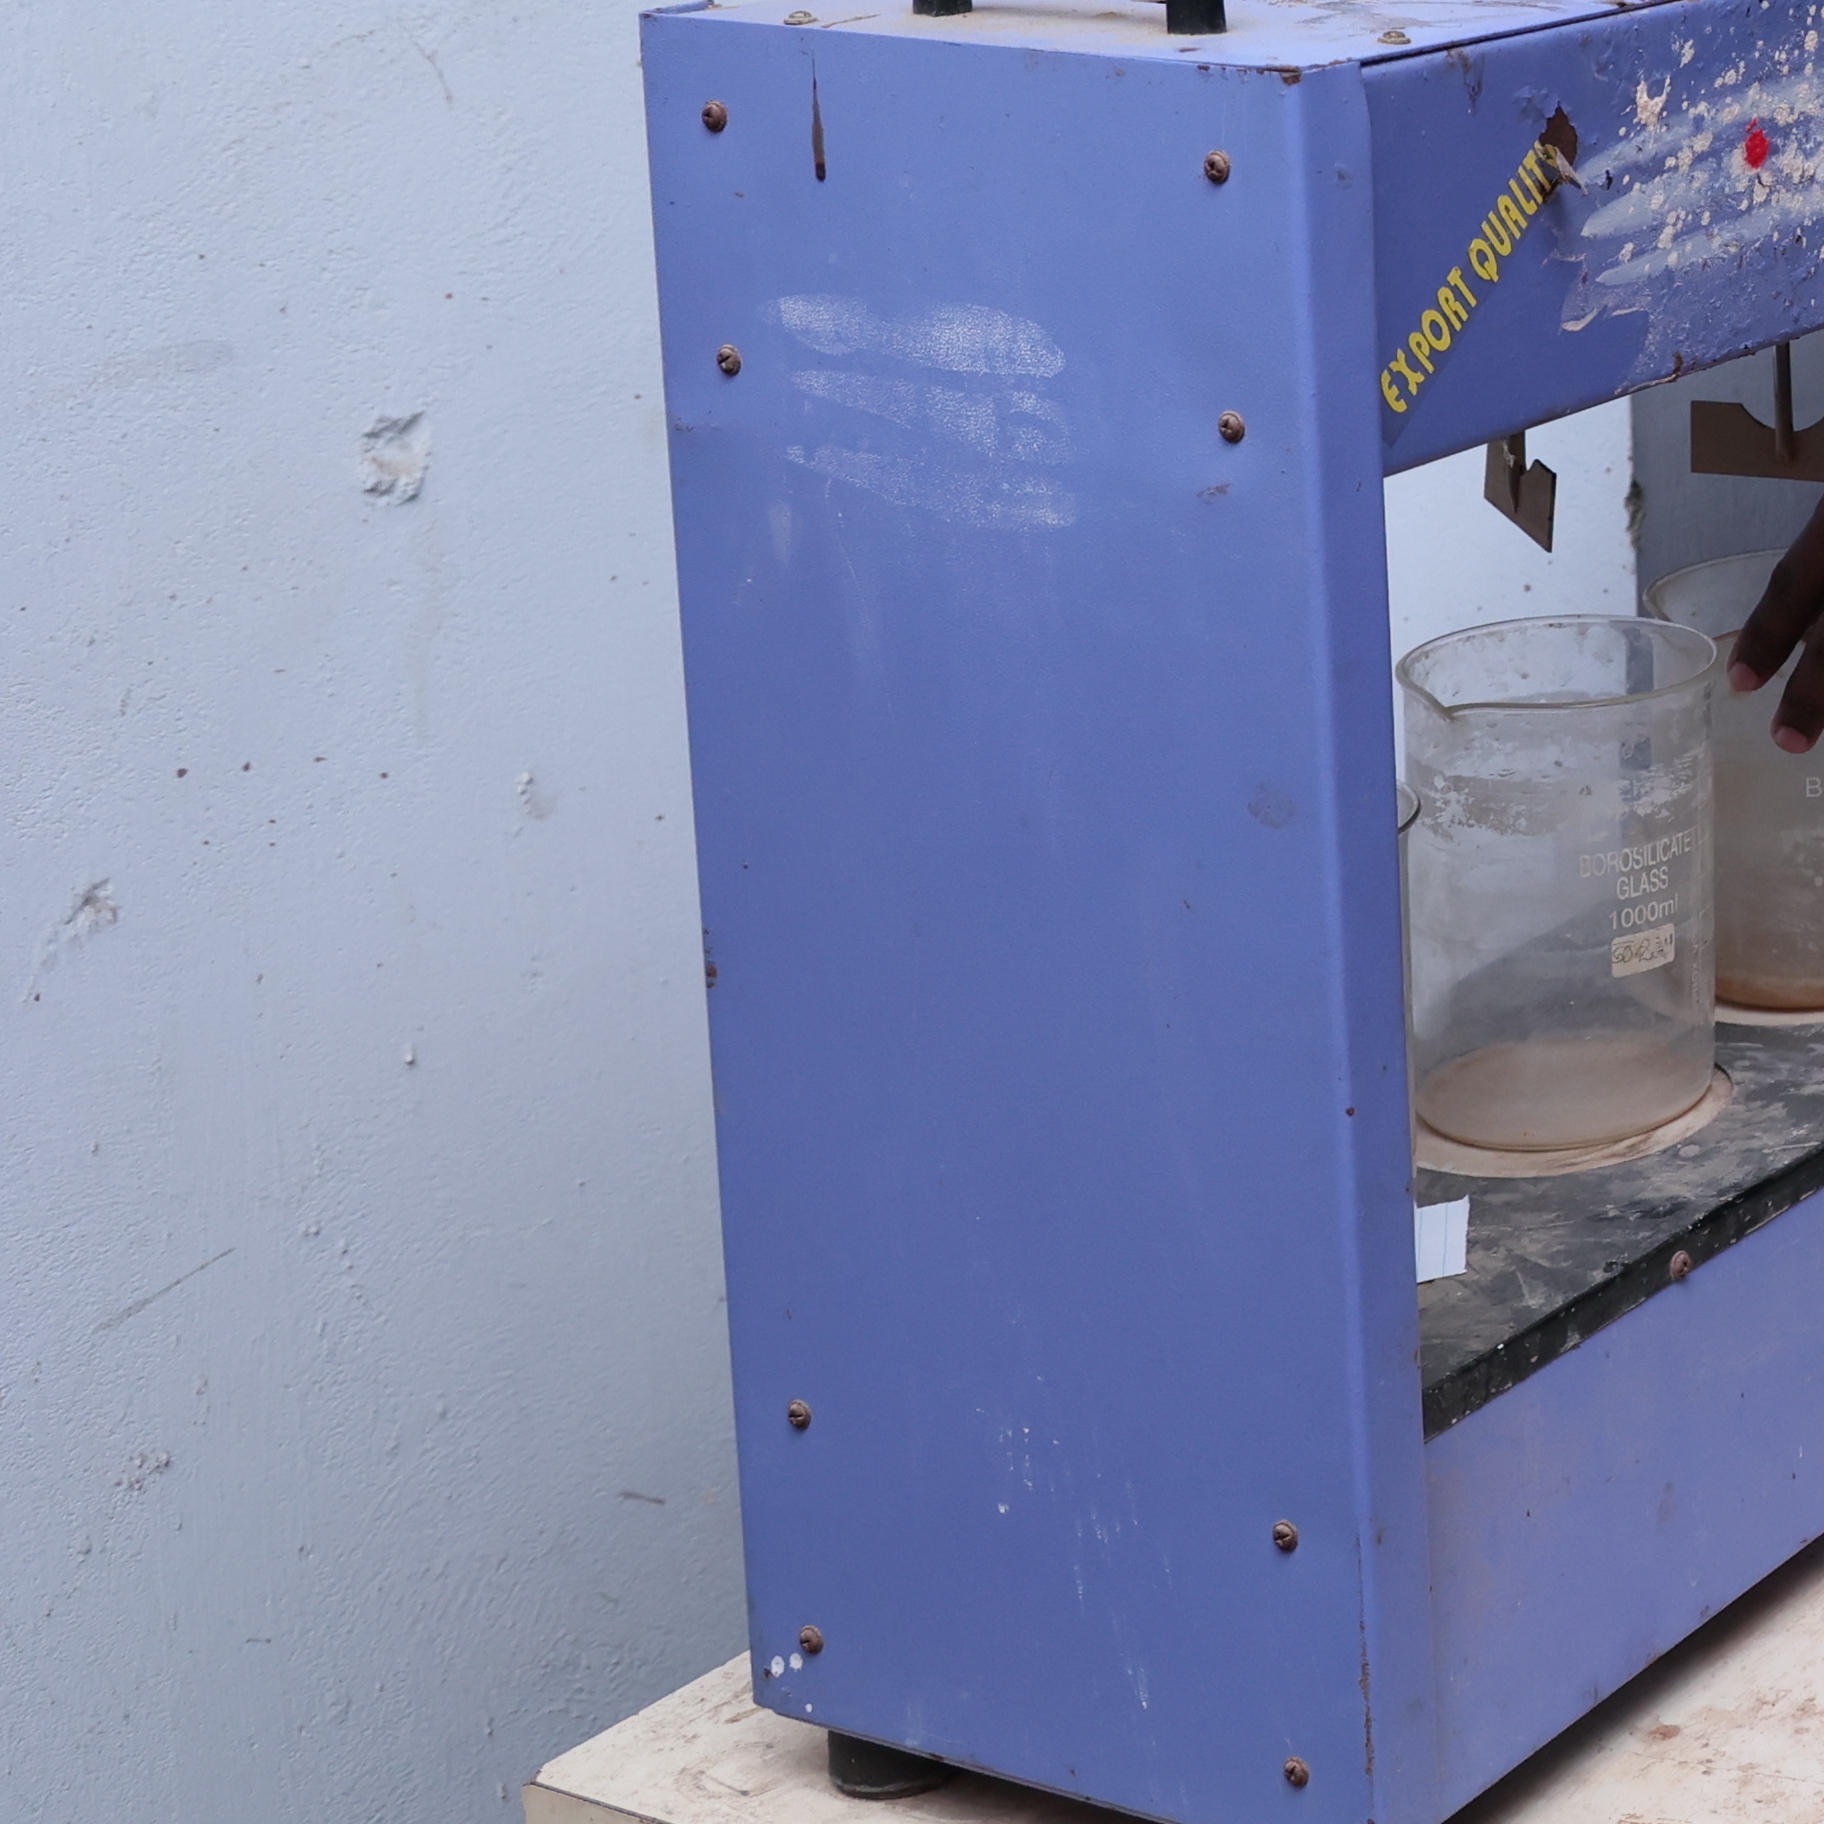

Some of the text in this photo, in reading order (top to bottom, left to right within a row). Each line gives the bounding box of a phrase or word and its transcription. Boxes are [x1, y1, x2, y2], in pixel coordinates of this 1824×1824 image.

[1380, 266, 1478, 413] EXPORT
[1579, 829, 1692, 878] BOROSILICATE
[1616, 865, 1669, 901] GLASS
[1608, 893, 1679, 931] 1000ml
